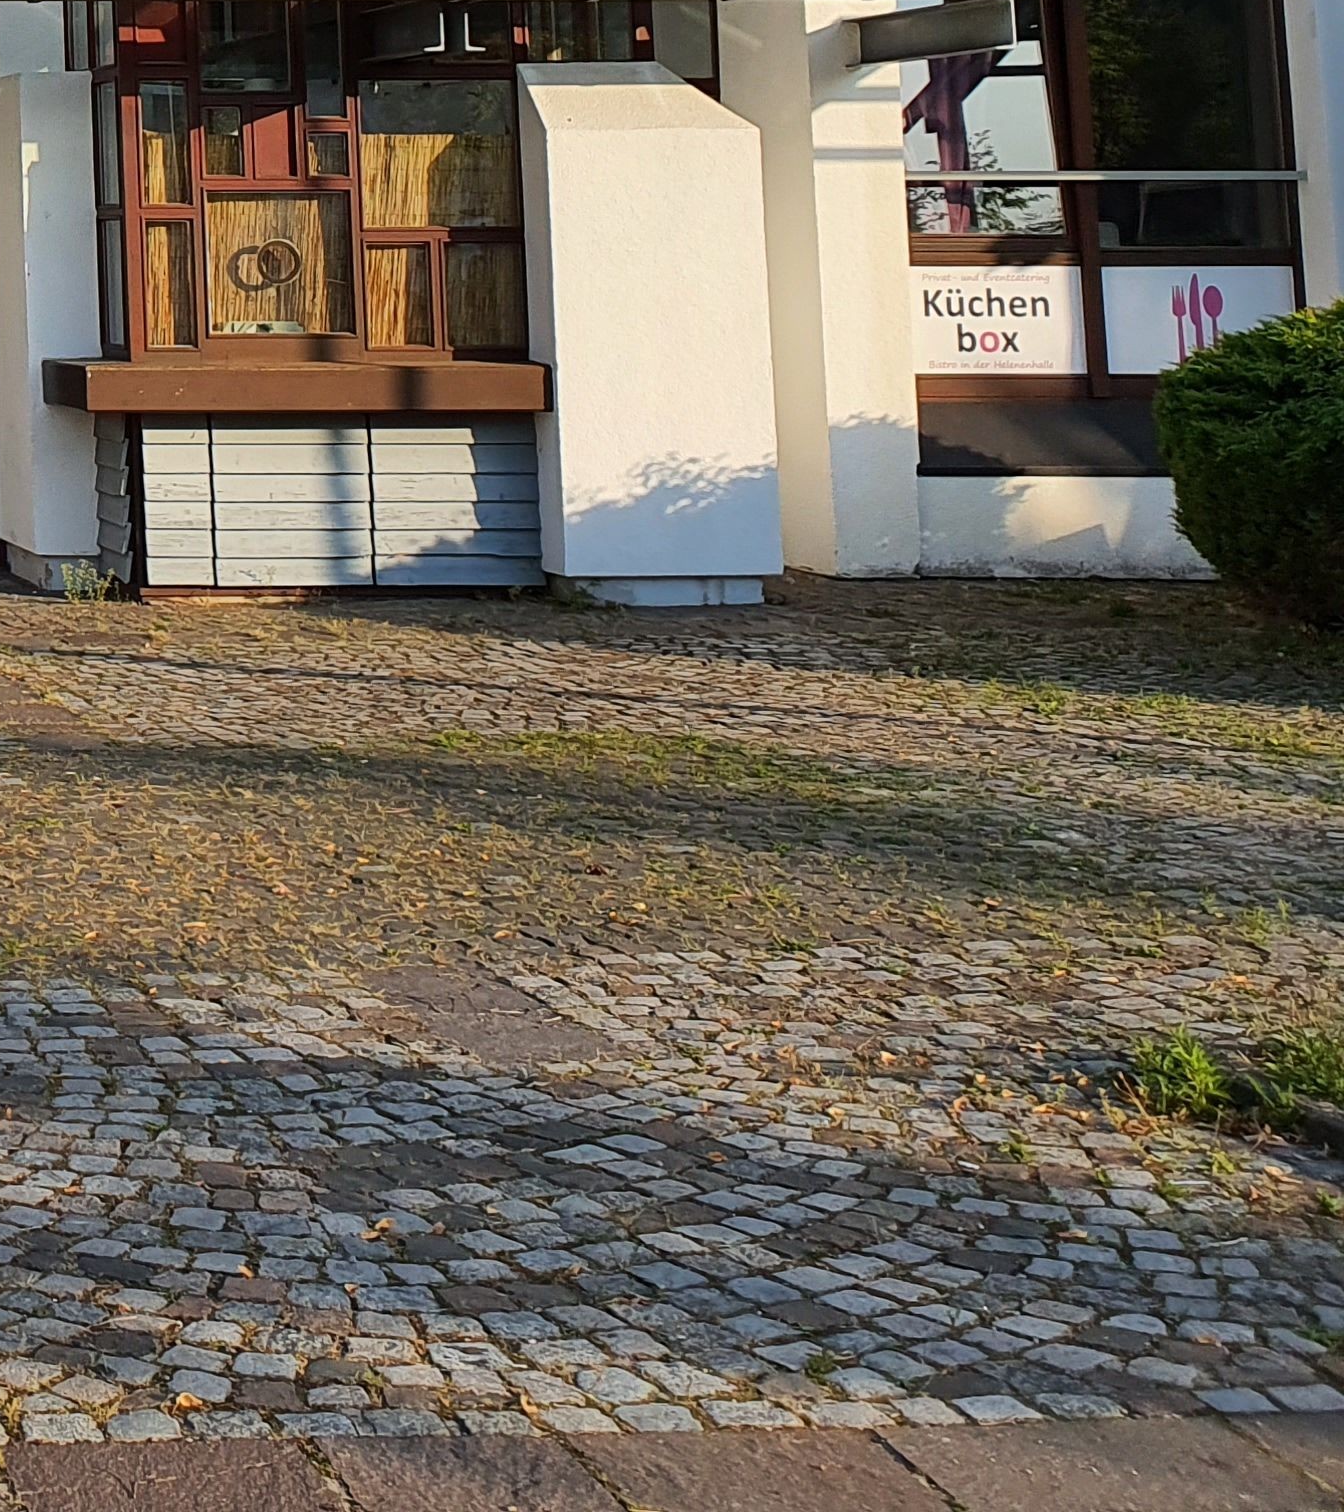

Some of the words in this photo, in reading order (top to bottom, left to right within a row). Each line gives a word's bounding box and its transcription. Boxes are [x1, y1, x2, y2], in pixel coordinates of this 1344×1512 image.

[960, 272, 980, 282] und
[983, 271, 1051, 284] Eventcatering
[922, 287, 1051, 318] Küchen
[956, 323, 1021, 354] box
[928, 359, 958, 369] Bistro
[960, 360, 970, 369] in
[973, 359, 991, 369] der
[993, 359, 1055, 369] Helenenhalle
